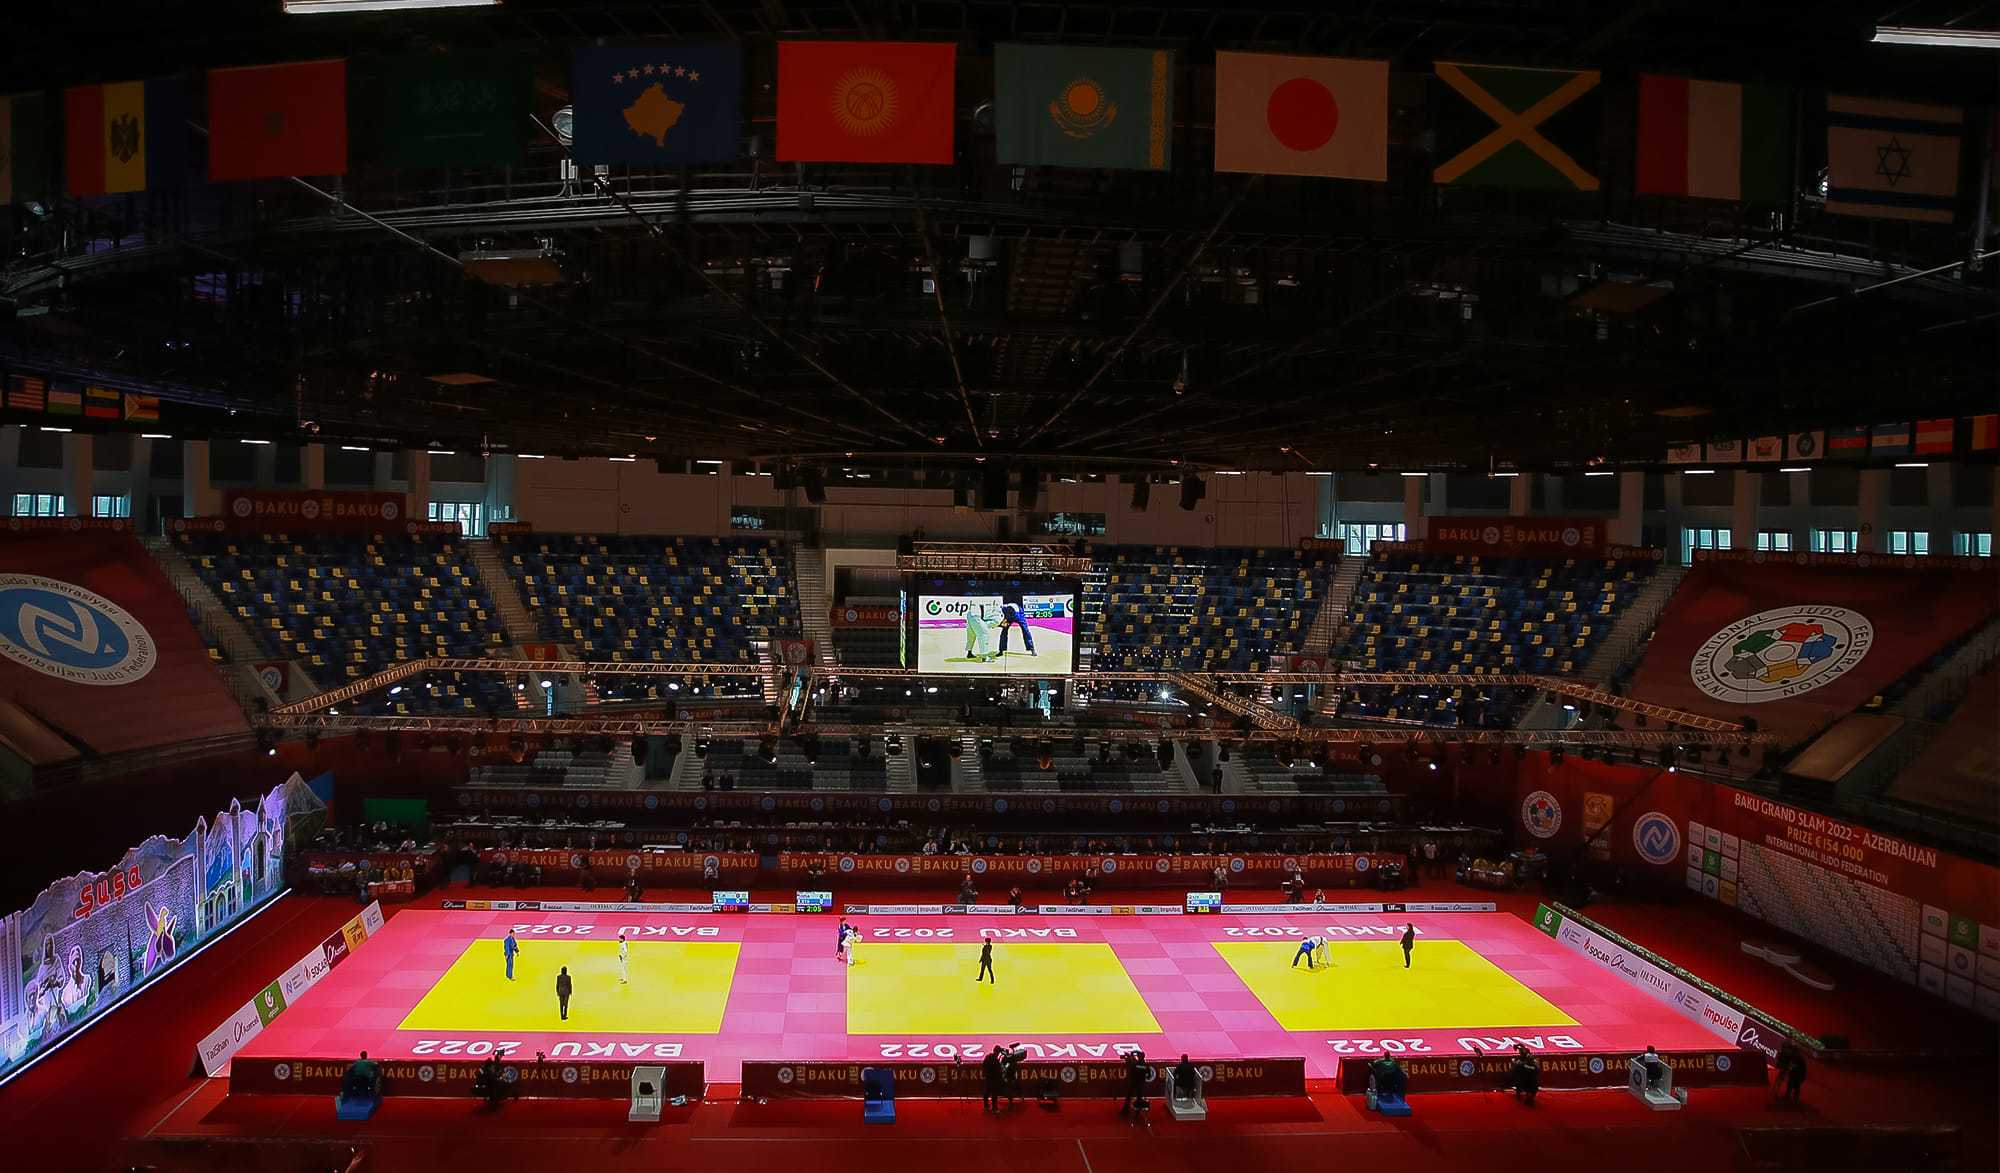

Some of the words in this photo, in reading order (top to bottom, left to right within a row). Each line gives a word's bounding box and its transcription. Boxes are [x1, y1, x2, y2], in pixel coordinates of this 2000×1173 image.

[255, 501, 299, 514] BAKU
[336, 503, 379, 516] BAKU
[1439, 527, 1481, 541] BAKU
[1517, 529, 1560, 543] BAKU
[859, 611, 887, 620] BAKU
[1035, 610, 1053, 618] 2:05
[1793, 607, 1846, 618] JUDO
[91, 671, 125, 681] Judo
[122, 634, 148, 675] Federation
[1695, 615, 1768, 697] INTERNATIONAL
[1783, 624, 1869, 697] FEDERATION
[1734, 792, 1760, 811] BAKU
[1761, 800, 1796, 824] GRAND
[1797, 811, 1825, 833] SLAM
[1827, 821, 1852, 841] 2022
[1862, 832, 1937, 868] AZERBAIJAN
[1787, 825, 1813, 845] PRIZE
[655, 856, 691, 868] BAKU
[722, 857, 758, 868] BAKU
[857, 859, 893, 870] BAKU
[924, 860, 959, 871] BAKU
[989, 860, 1024, 871] BAKU
[1054, 860, 1088, 871] BAKU
[1119, 860, 1153, 870] BAKU
[1184, 860, 1217, 870] BAKU
[1247, 859, 1281, 870] BAKU
[1310, 859, 1344, 869] BAKU
[1765, 833, 1819, 861] INTERNATIONAL
[1820, 851, 1840, 868] JUDO
[1841, 858, 1888, 885] FEDERATION
[512, 923, 595, 935] 2022
[618, 925, 720, 937] BAKU
[872, 927, 955, 938] 2022
[980, 927, 1078, 938] BAKU
[1223, 926, 1300, 937] 2022
[1588, 946, 1610, 964] SOCAR
[1703, 1004, 1739, 1032] impulse
[412, 1040, 523, 1056] 2022
[551, 1042, 684, 1057] BAKU
[879, 1043, 985, 1057] 2022
[1327, 1038, 1432, 1052] 2022
[1457, 1035, 1585, 1051] BAKU
[305, 1063, 344, 1077] BAKU
[381, 1063, 415, 1078] AKU
[521, 1068, 560, 1080] BAKU
[592, 1068, 632, 1080] BAKU
[809, 1069, 847, 1081] BAKU
[1021, 1068, 1058, 1080] BAKU
[1090, 1068, 1127, 1080] BAKU
[1227, 1066, 1264, 1078] BAKU
[1411, 1063, 1447, 1074] BAKU
[1542, 1060, 1577, 1071] BAKU
[1669, 1058, 1704, 1069] BAKU
